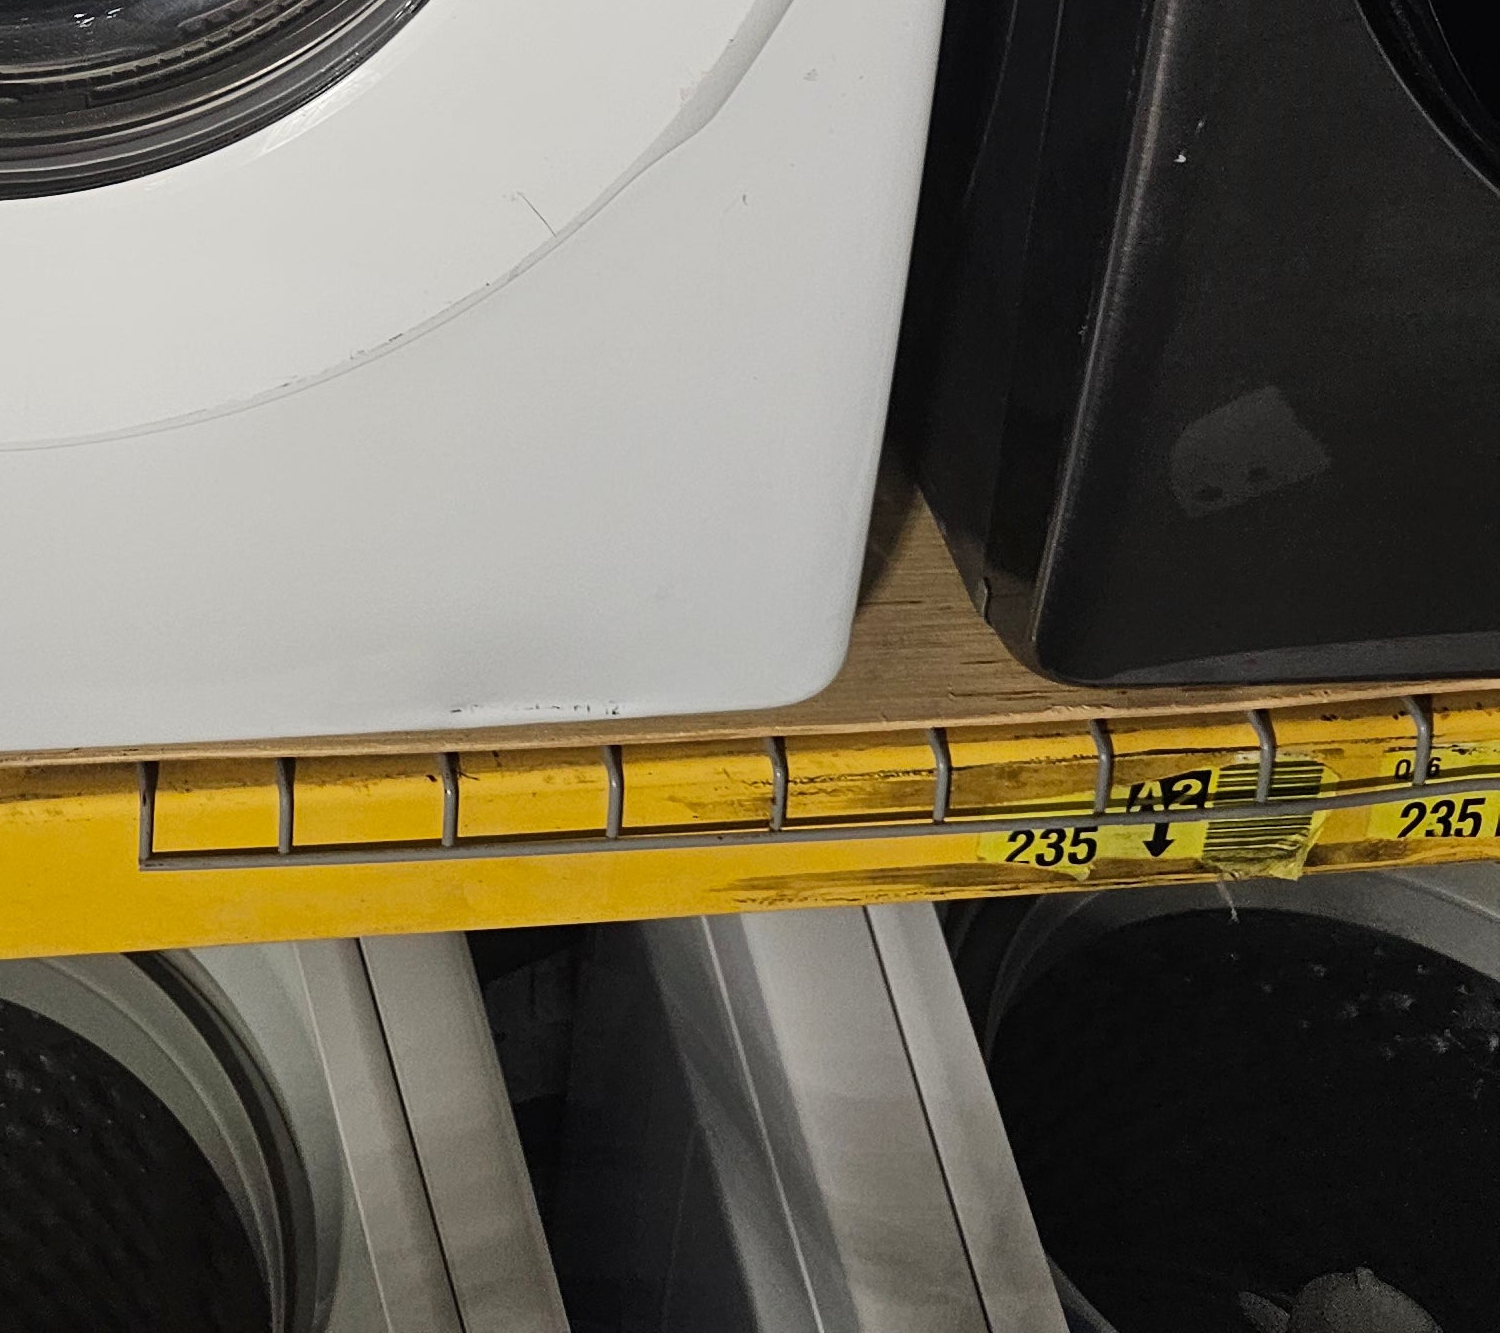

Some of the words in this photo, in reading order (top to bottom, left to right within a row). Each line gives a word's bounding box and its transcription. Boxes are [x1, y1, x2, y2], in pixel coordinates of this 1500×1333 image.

[1394, 756, 1442, 781] 06
[1396, 797, 1486, 838] 235
[1004, 825, 1099, 867] 235
